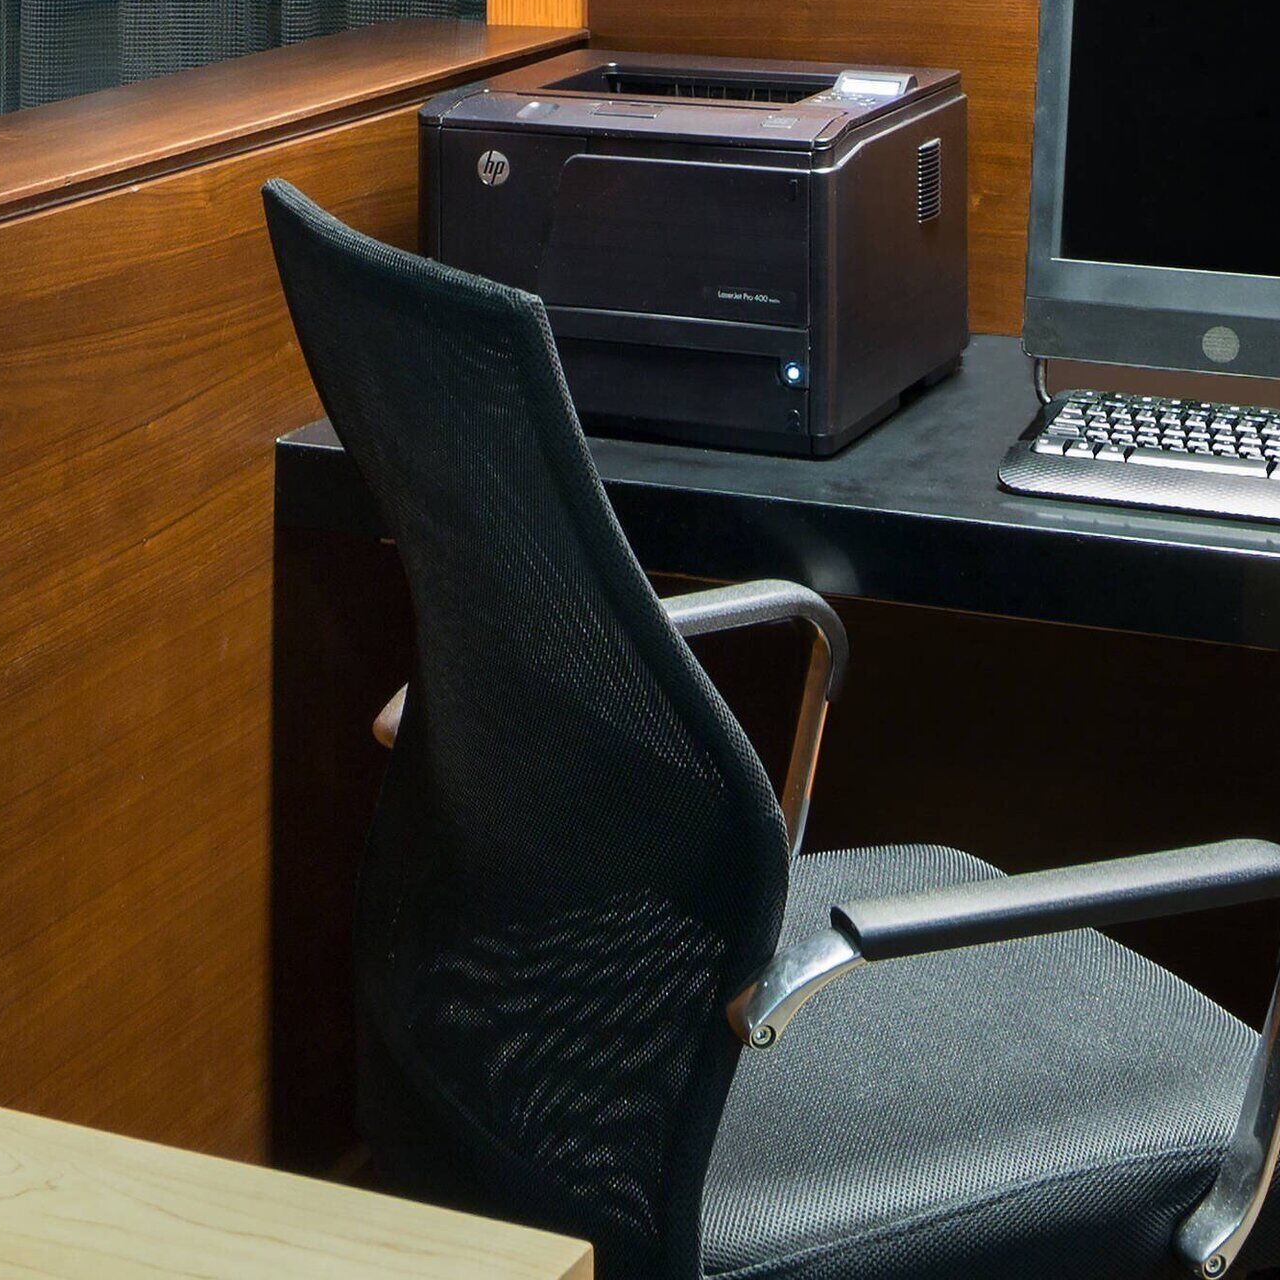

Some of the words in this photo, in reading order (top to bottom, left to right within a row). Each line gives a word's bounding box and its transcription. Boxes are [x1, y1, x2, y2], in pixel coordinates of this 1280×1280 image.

[482, 149, 507, 185] hp
[743, 293, 754, 301] Pro
[754, 294, 769, 303] 400
